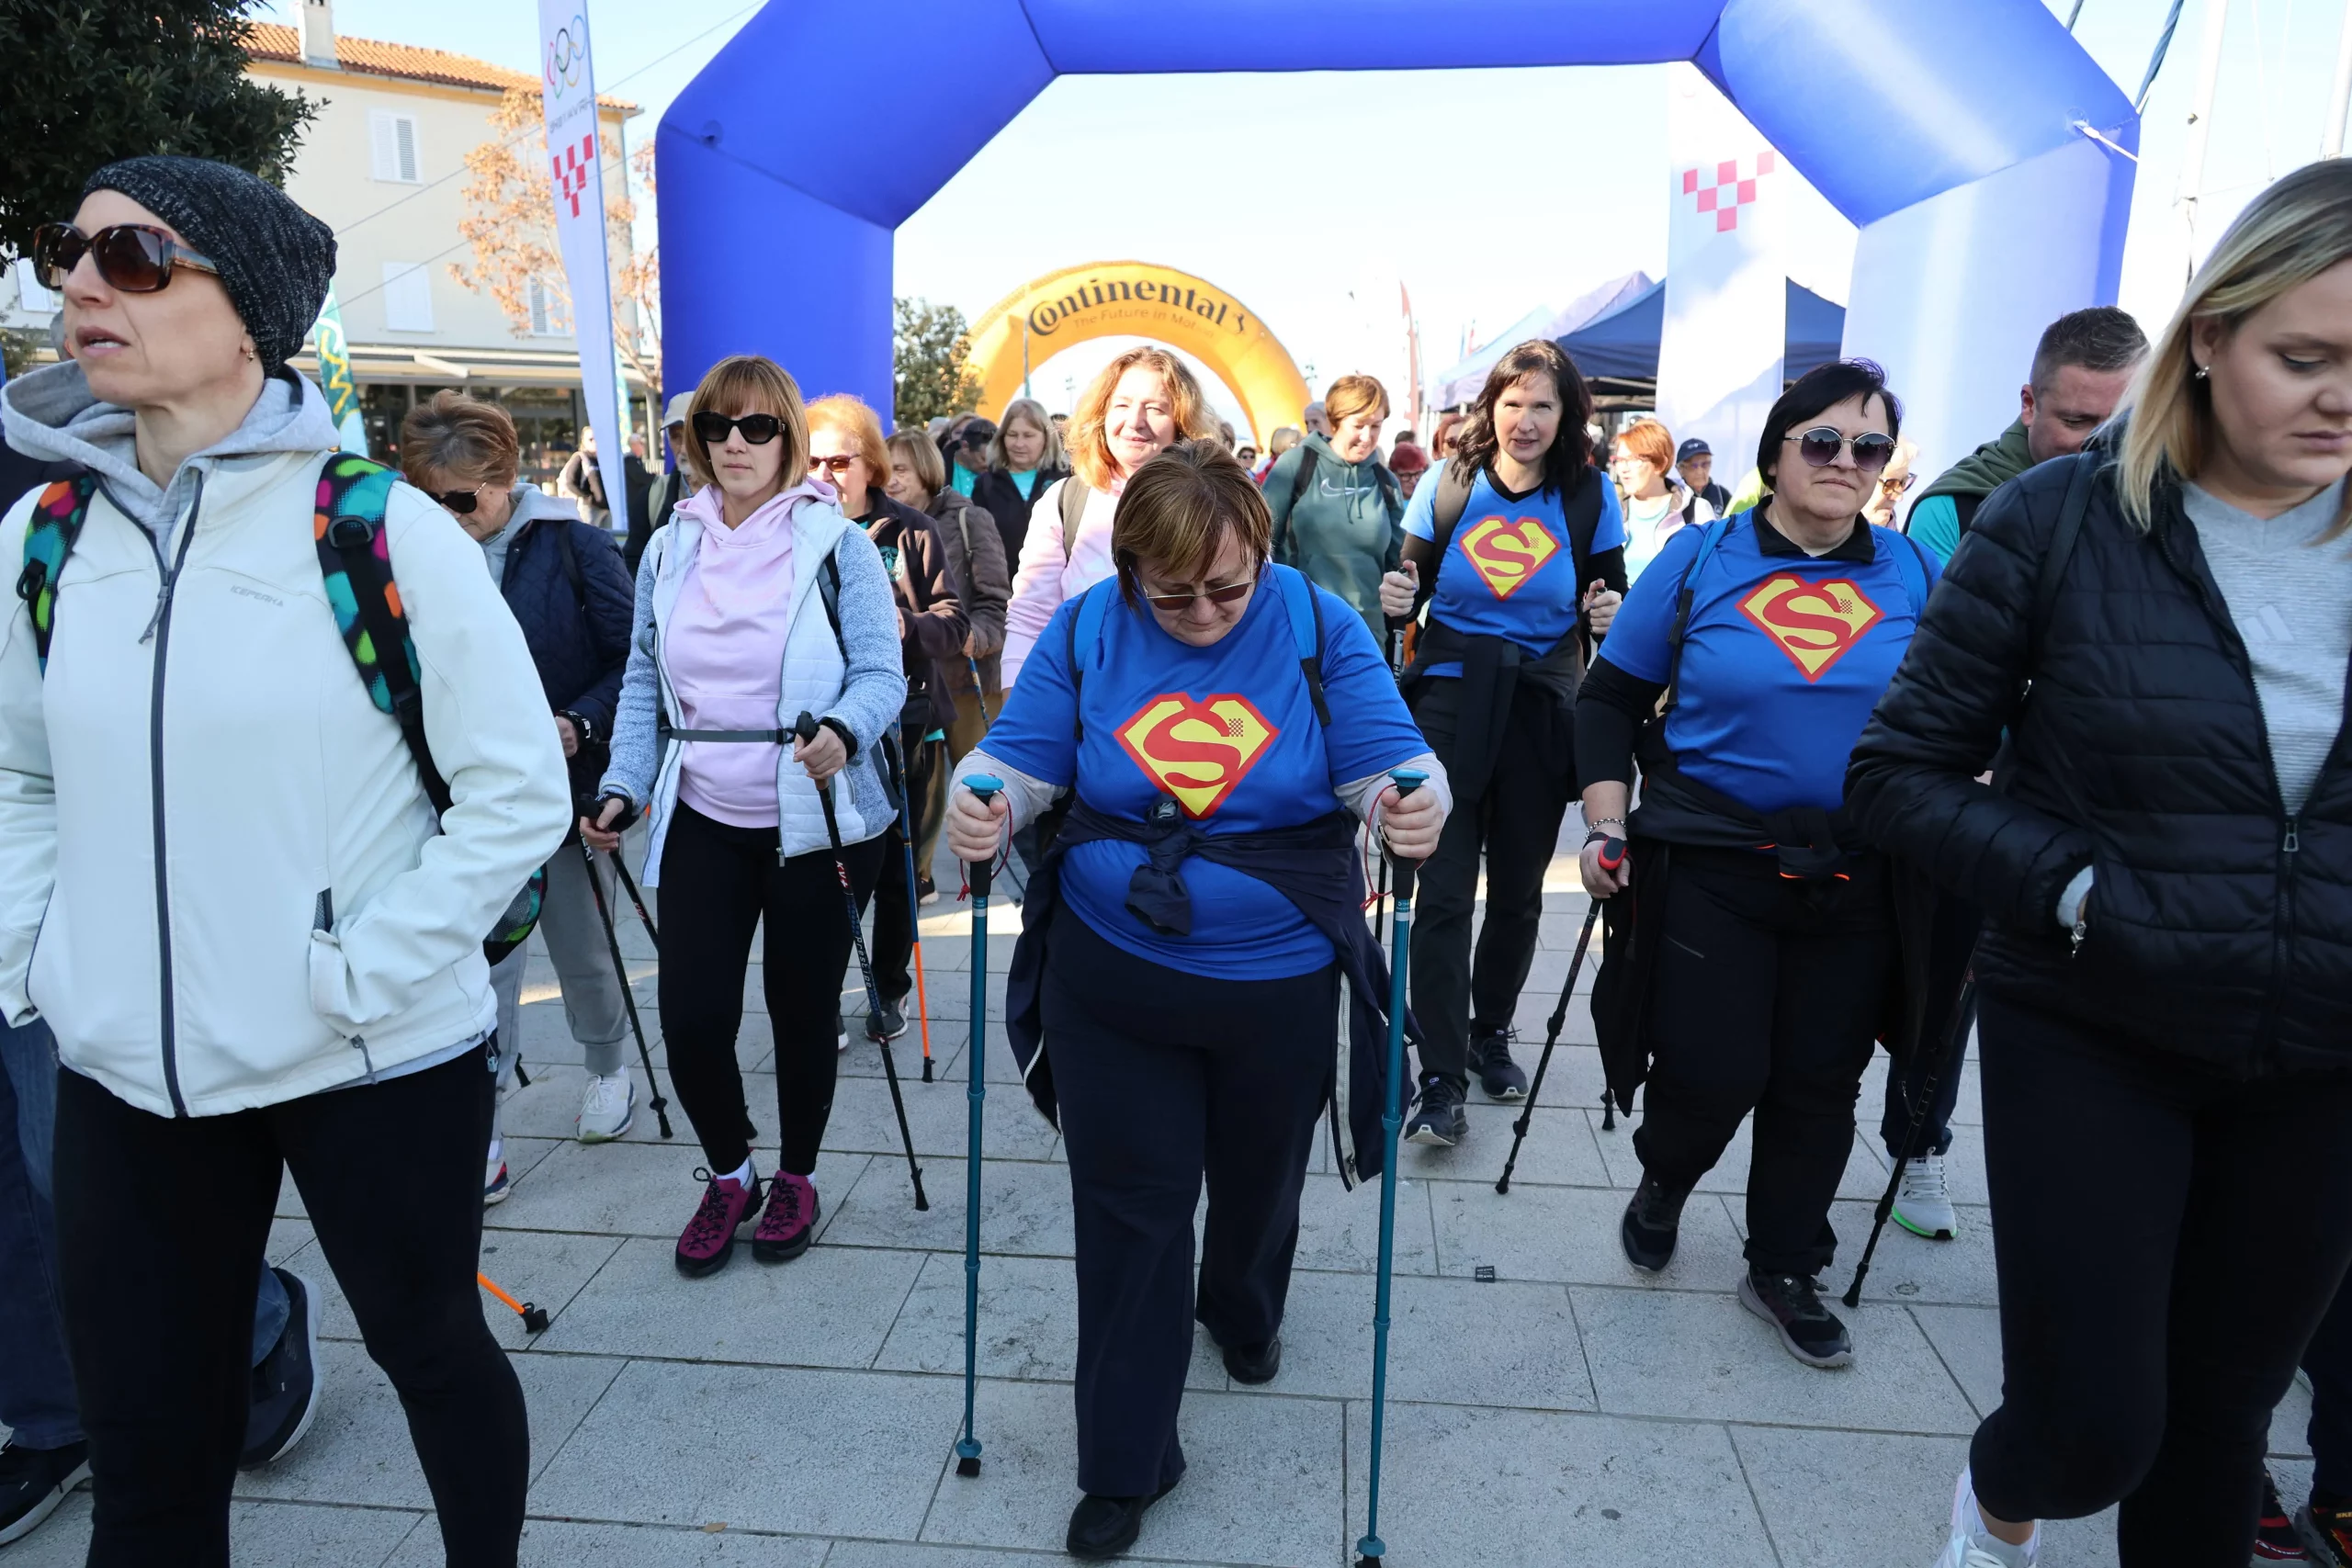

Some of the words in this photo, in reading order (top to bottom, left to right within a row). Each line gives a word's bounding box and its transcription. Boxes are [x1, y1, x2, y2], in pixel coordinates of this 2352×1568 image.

[1029, 278, 1227, 336] Continental
[1073, 314, 1098, 328] The
[1101, 308, 1148, 321] Future
[1153, 309, 1167, 320] in
